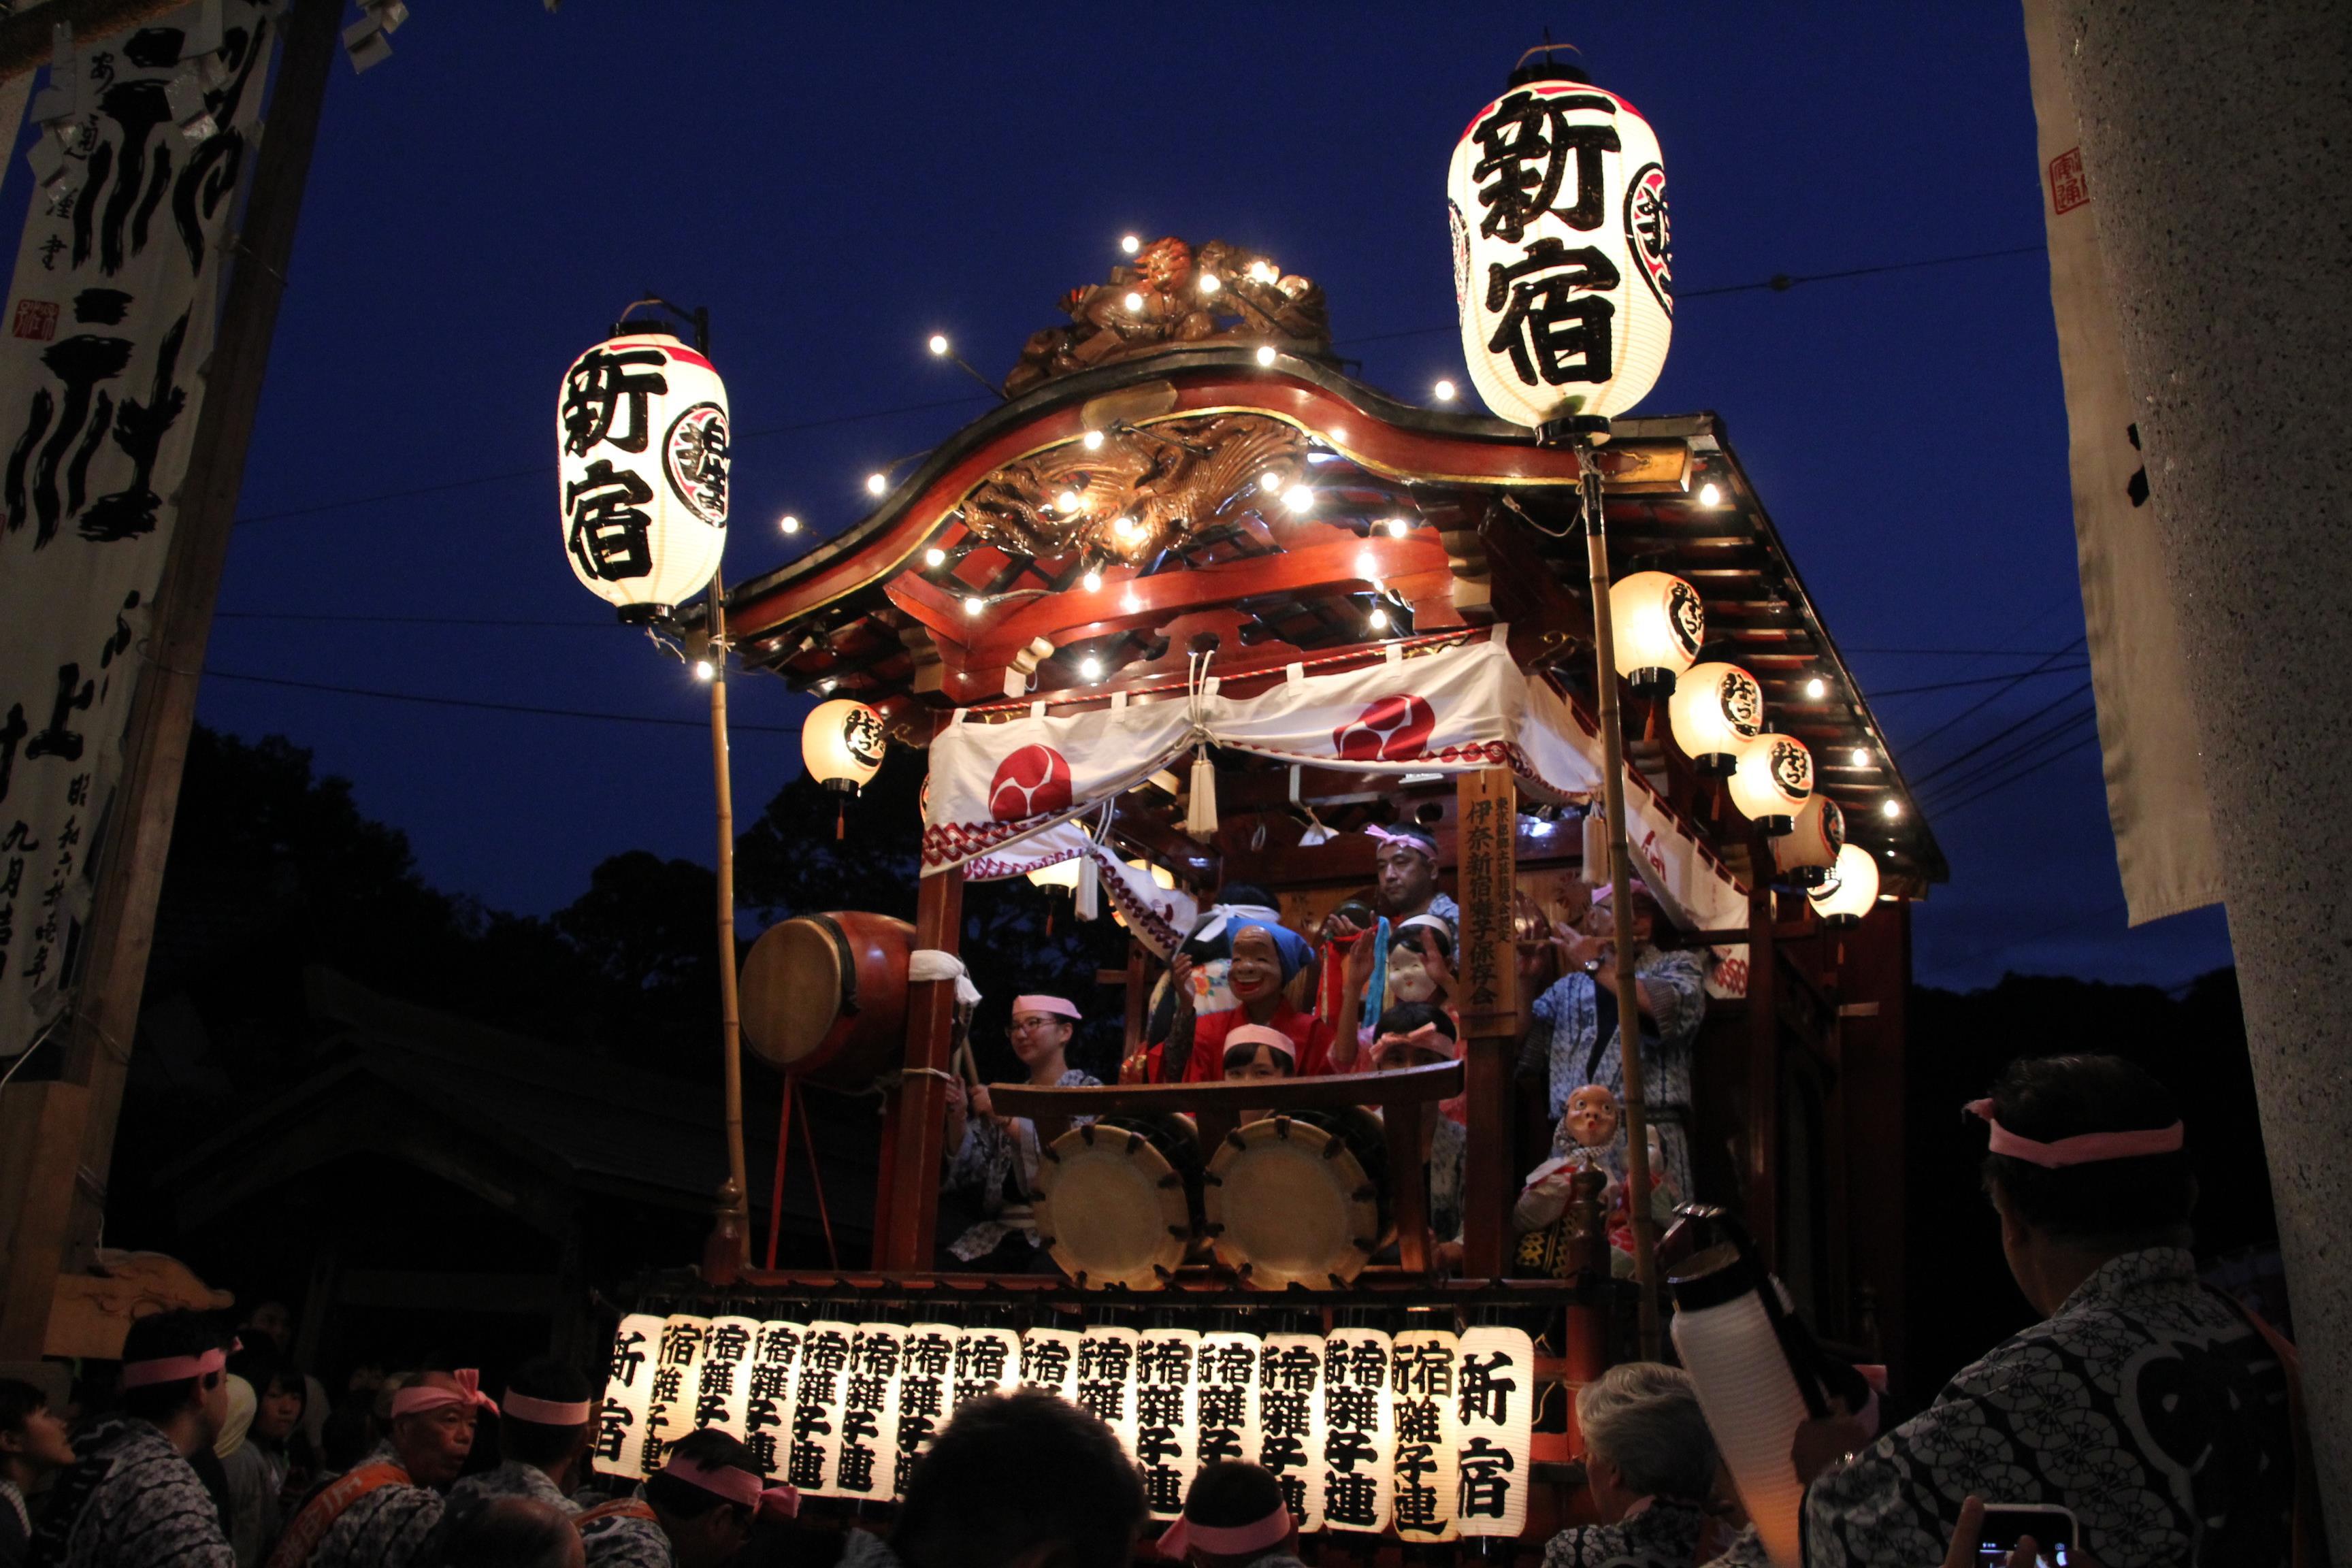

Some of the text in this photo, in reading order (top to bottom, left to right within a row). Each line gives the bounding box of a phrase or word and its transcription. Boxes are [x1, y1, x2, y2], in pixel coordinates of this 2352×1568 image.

[1472, 91, 1621, 387] 新宿
[562, 348, 669, 582] 新宿
[1457, 1350, 1517, 1518] 新宿
